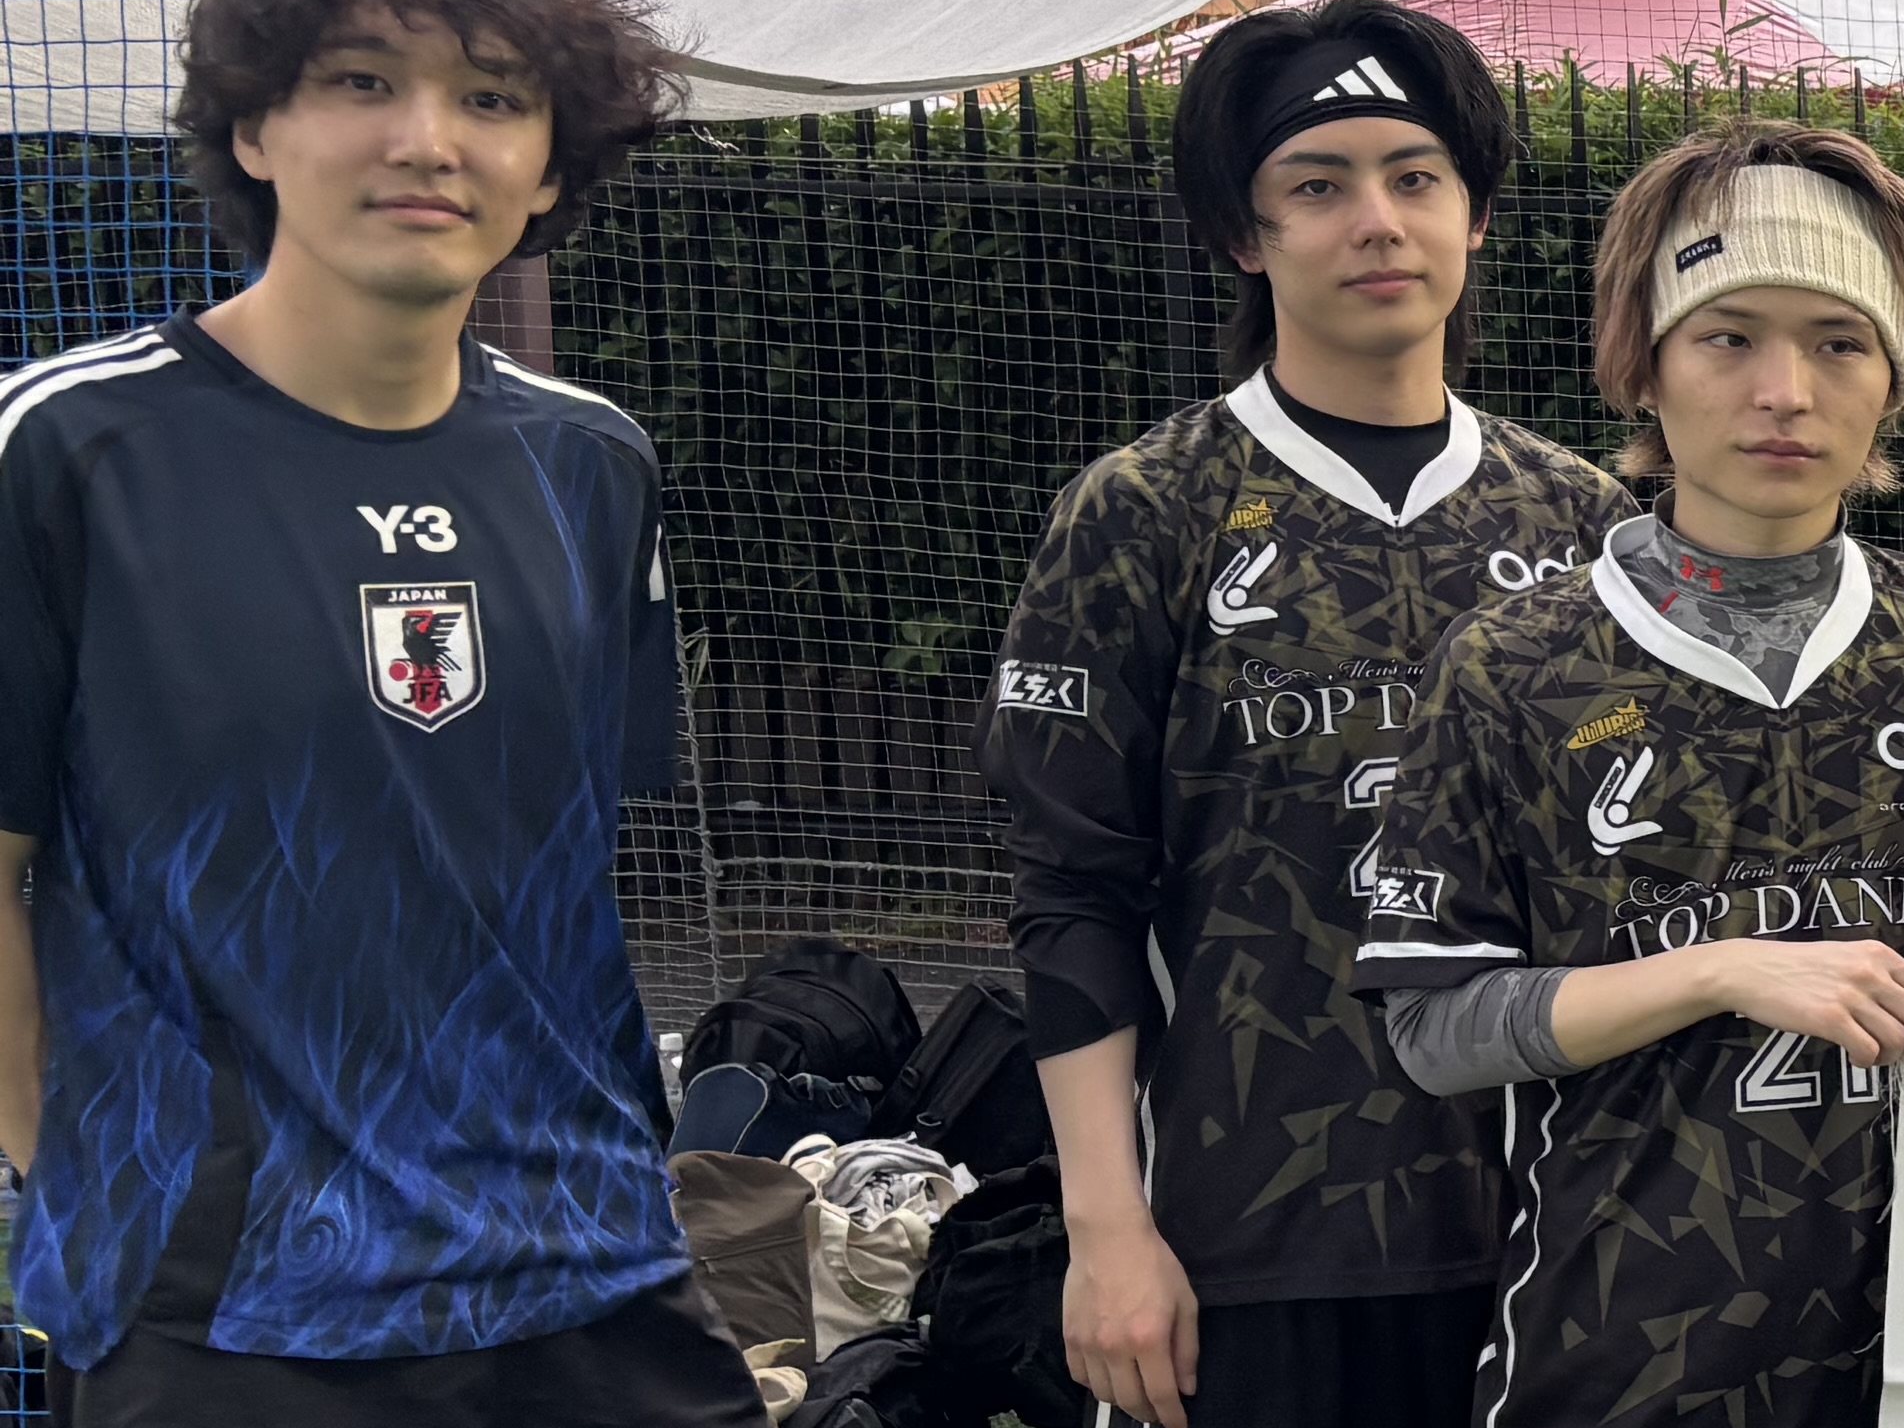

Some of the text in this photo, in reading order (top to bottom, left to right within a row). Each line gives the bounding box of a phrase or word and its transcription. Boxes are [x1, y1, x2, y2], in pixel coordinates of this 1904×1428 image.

[356, 504, 458, 554] Y-3
[388, 589, 448, 603] JAPAN
[403, 682, 453, 704] JFA
[1222, 685, 1356, 746] TOP
[1850, 843, 1898, 872] club
[1610, 890, 1731, 960] TOP
